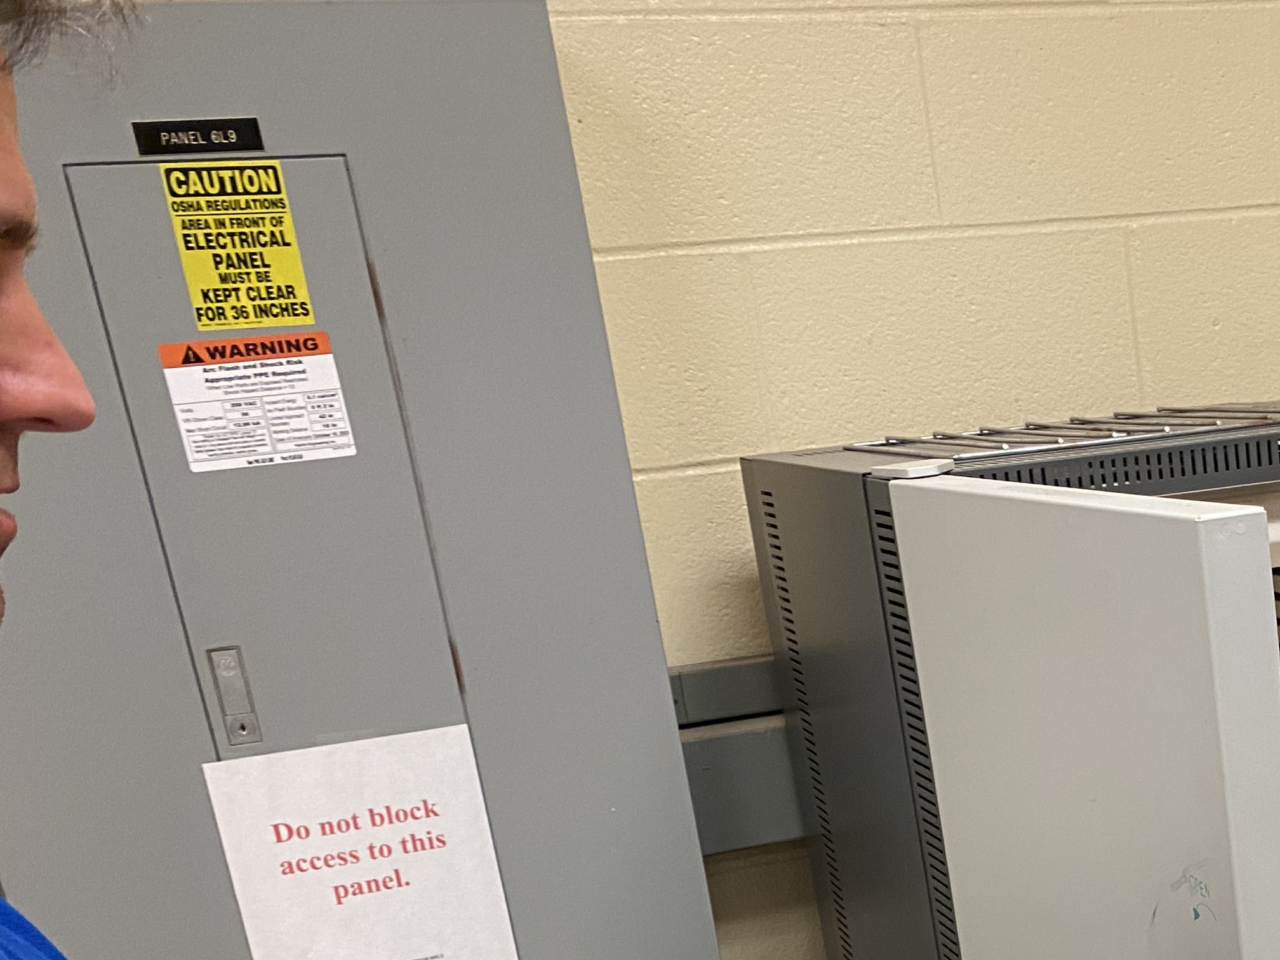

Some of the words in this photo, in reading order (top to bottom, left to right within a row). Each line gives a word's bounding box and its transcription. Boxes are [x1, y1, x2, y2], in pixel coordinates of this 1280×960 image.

[160, 131, 207, 145] PANEL
[210, 129, 237, 143] 6L9
[169, 168, 278, 195] CAUTION
[171, 200, 205, 212] OSHA
[206, 198, 286, 211] REGULATIONS
[181, 218, 211, 230] AREA
[213, 218, 226, 229] IN
[229, 217, 266, 229] FRONT
[270, 216, 284, 227] OF
[182, 230, 291, 250] ELECTRICAL
[212, 252, 271, 270] PANEL
[219, 272, 252, 284] MUST
[256, 271, 272, 283] BE
[201, 287, 241, 303] KEPT
[246, 285, 297, 301] CLEAR
[195, 306, 227, 322] FOR
[230, 305, 250, 320] 36
[253, 302, 310, 318] INCHES
[205, 337, 319, 360] WARNING
[270, 821, 311, 844] Do
[319, 812, 362, 836] not
[368, 799, 441, 828] block
[279, 848, 361, 876] access
[367, 842, 393, 860] to
[400, 830, 447, 854] this
[332, 868, 411, 905] panel.
